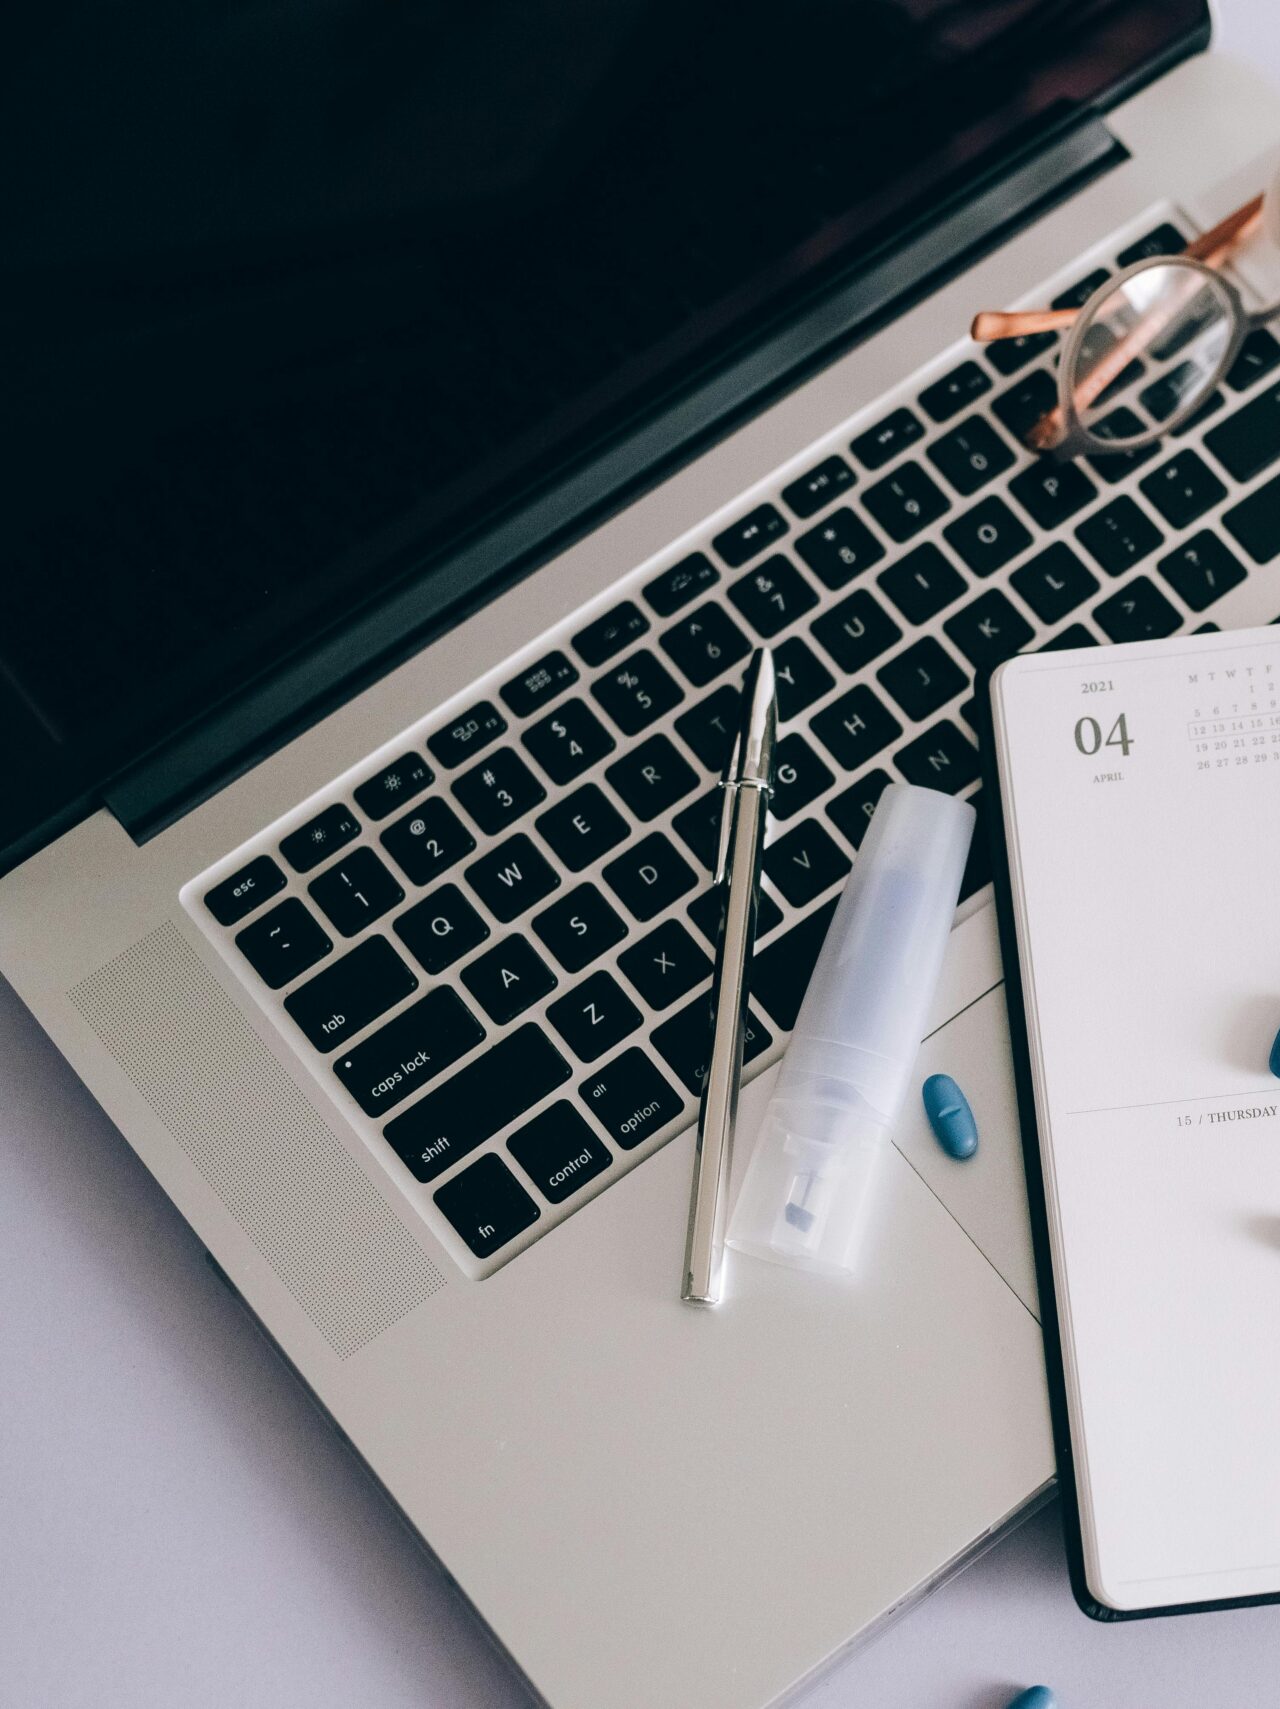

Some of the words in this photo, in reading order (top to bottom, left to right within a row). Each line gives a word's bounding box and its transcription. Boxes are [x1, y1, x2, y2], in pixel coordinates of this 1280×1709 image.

[1043, 477, 1059, 497] P
[904, 499, 920, 516] 9
[977, 524, 998, 543] O
[838, 546, 856, 564] 8
[756, 576, 774, 592] &
[1045, 574, 1065, 589] L
[771, 593, 785, 611] 7
[844, 616, 865, 638] U
[978, 617, 999, 638] K
[707, 643, 721, 658] 6
[618, 672, 638, 689] %
[778, 666, 795, 685] Y
[917, 668, 930, 686] J
[1188, 674, 1198, 684] M
[1208, 672, 1216, 681] T
[1226, 670, 1236, 679] W
[1246, 667, 1253, 676] T
[1265, 665, 1272, 674] F
[1081, 680, 1115, 694] 2021
[1249, 684, 1254, 693] 1
[1268, 682, 1275, 691] 2
[636, 691, 651, 709] 5
[1194, 708, 1201, 718] 5
[1213, 706, 1220, 715] 6
[1232, 704, 1238, 713] 7
[1251, 702, 1257, 711] 8
[1270, 700, 1276, 709] 9
[551, 721, 567, 737] $
[710, 716, 726, 733] T
[843, 713, 866, 736] H
[1193, 726, 1206, 735] 12
[1212, 723, 1225, 733] 13
[1232, 721, 1244, 731] 14
[1251, 718, 1263, 728] 15
[1074, 712, 1135, 756] 04
[569, 740, 583, 756] 4
[1195, 743, 1208, 752] 19
[1214, 740, 1227, 750] 20
[1233, 738, 1245, 748] 21
[1252, 736, 1265, 745] 22
[928, 749, 951, 771] N
[1197, 760, 1210, 770] 26
[1216, 758, 1229, 768] 27
[1235, 755, 1249, 765] 28
[1254, 753, 1268, 763] 29
[413, 769, 424, 779] F2
[482, 769, 496, 787] #
[642, 766, 661, 784] R
[778, 764, 797, 783] G
[1093, 772, 1125, 784] APRIL
[497, 790, 513, 806] 3
[341, 822, 351, 831] F1
[410, 819, 426, 835] @
[572, 815, 591, 834] E
[427, 840, 444, 857] 2
[793, 851, 810, 869] V
[341, 872, 352, 886] !
[498, 863, 522, 887] W
[639, 866, 658, 884] D
[233, 878, 255, 897] esc
[354, 892, 369, 906] 1
[431, 917, 454, 936] Q
[570, 916, 588, 936] S
[653, 952, 676, 974] X
[501, 969, 520, 988] A
[583, 1003, 604, 1025] Z
[322, 1014, 346, 1034] tab
[371, 1071, 403, 1097] caps
[400, 1052, 431, 1075] lock
[592, 1084, 607, 1098] alt
[620, 1101, 661, 1133] option
[1176, 1115, 1192, 1127] 15
[1207, 1105, 1278, 1124] THURSDAY
[421, 1136, 451, 1163] shift
[549, 1149, 593, 1187] control
[478, 1224, 495, 1239] fn
